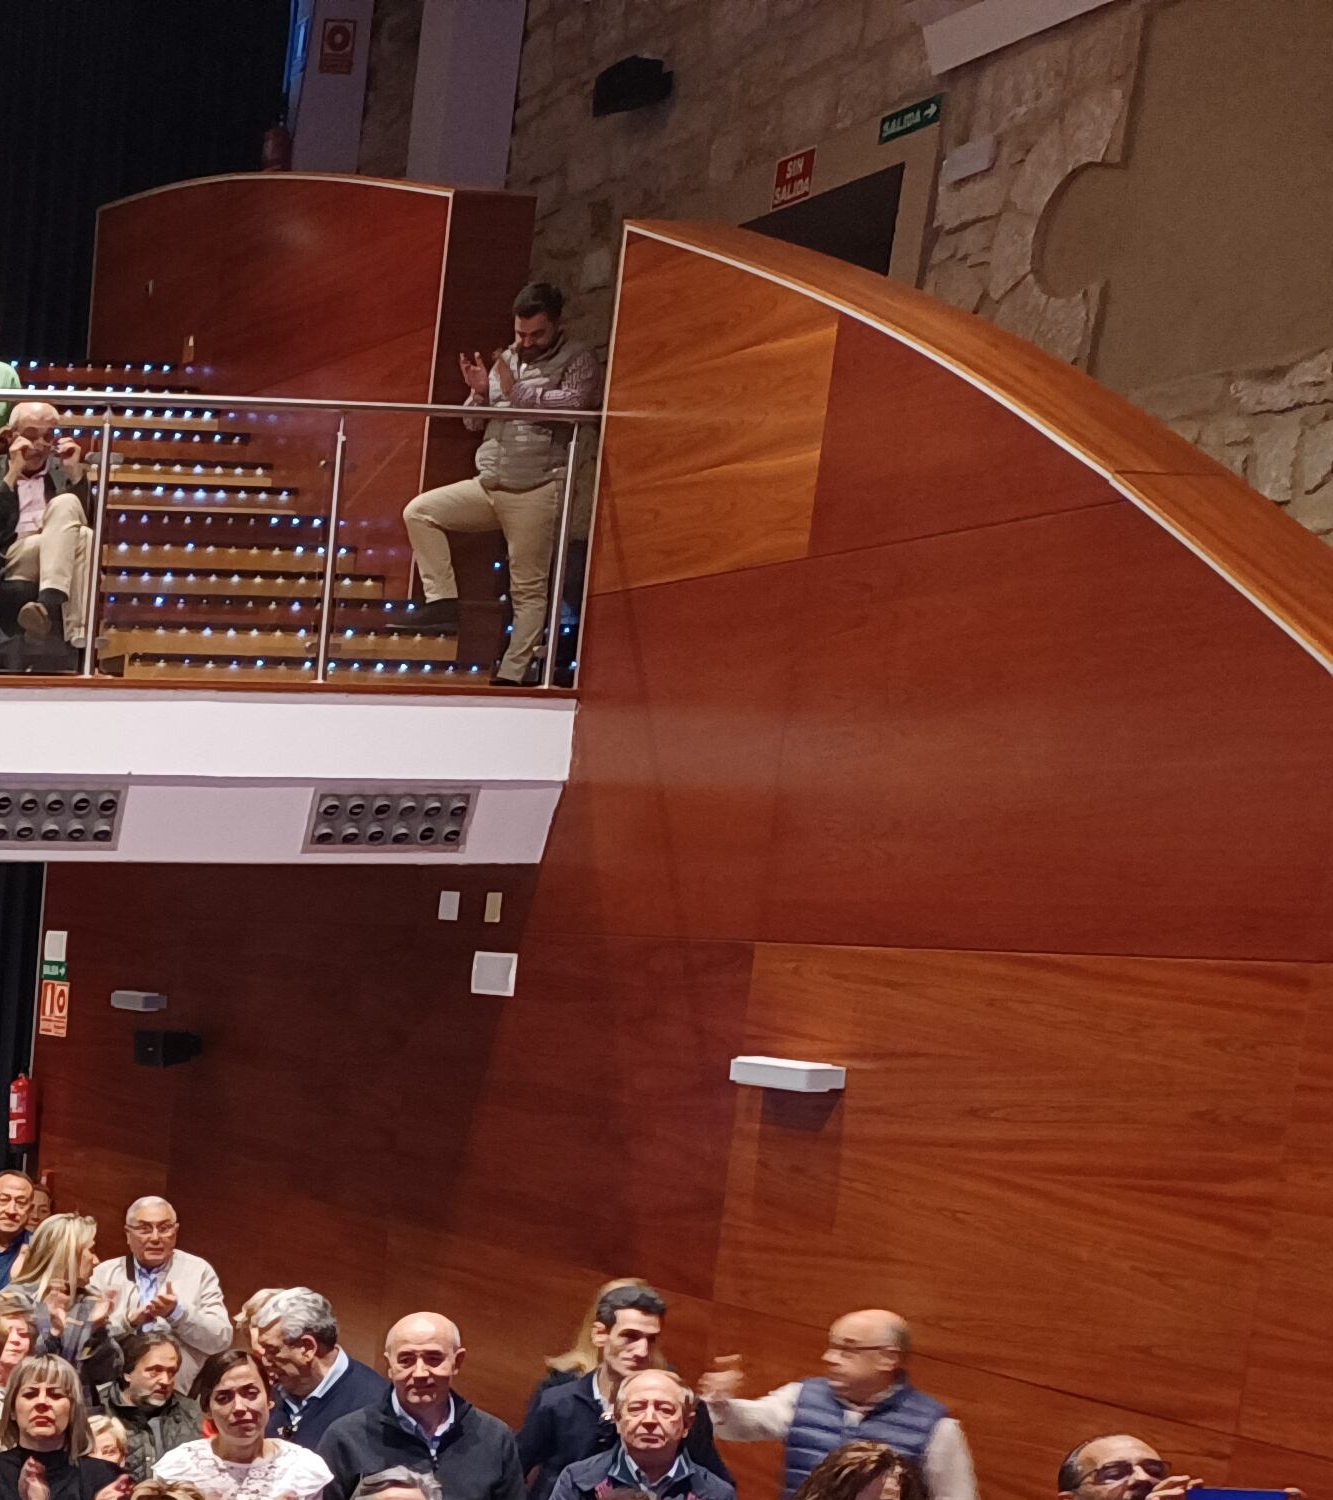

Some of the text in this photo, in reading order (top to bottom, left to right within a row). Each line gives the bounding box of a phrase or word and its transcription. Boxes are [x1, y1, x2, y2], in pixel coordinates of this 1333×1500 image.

[882, 109, 921, 138] SALIDA
[785, 156, 805, 180] SIN
[774, 177, 810, 204] SALIDA
